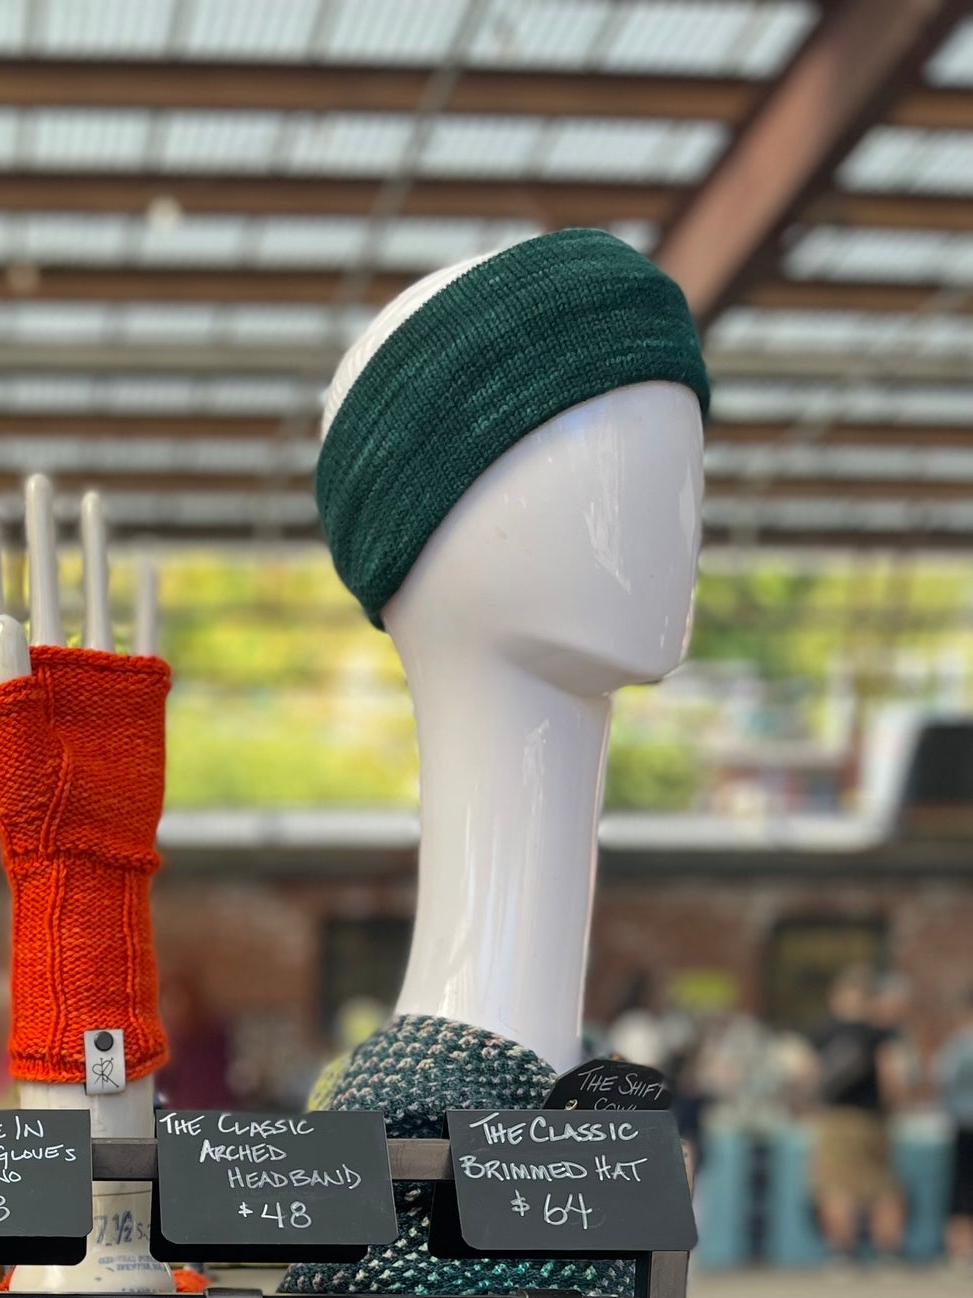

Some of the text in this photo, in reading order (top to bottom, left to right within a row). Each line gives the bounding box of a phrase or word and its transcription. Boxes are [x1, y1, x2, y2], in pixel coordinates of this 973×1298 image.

[578, 1065, 618, 1092] THE
[15, 1116, 44, 1140] IN
[159, 1112, 315, 1138] THE CLASSIC
[469, 1112, 639, 1145] THE CLASSIC
[199, 1139, 287, 1163] ARCHED
[459, 1155, 648, 1182] BRIMMED HAT
